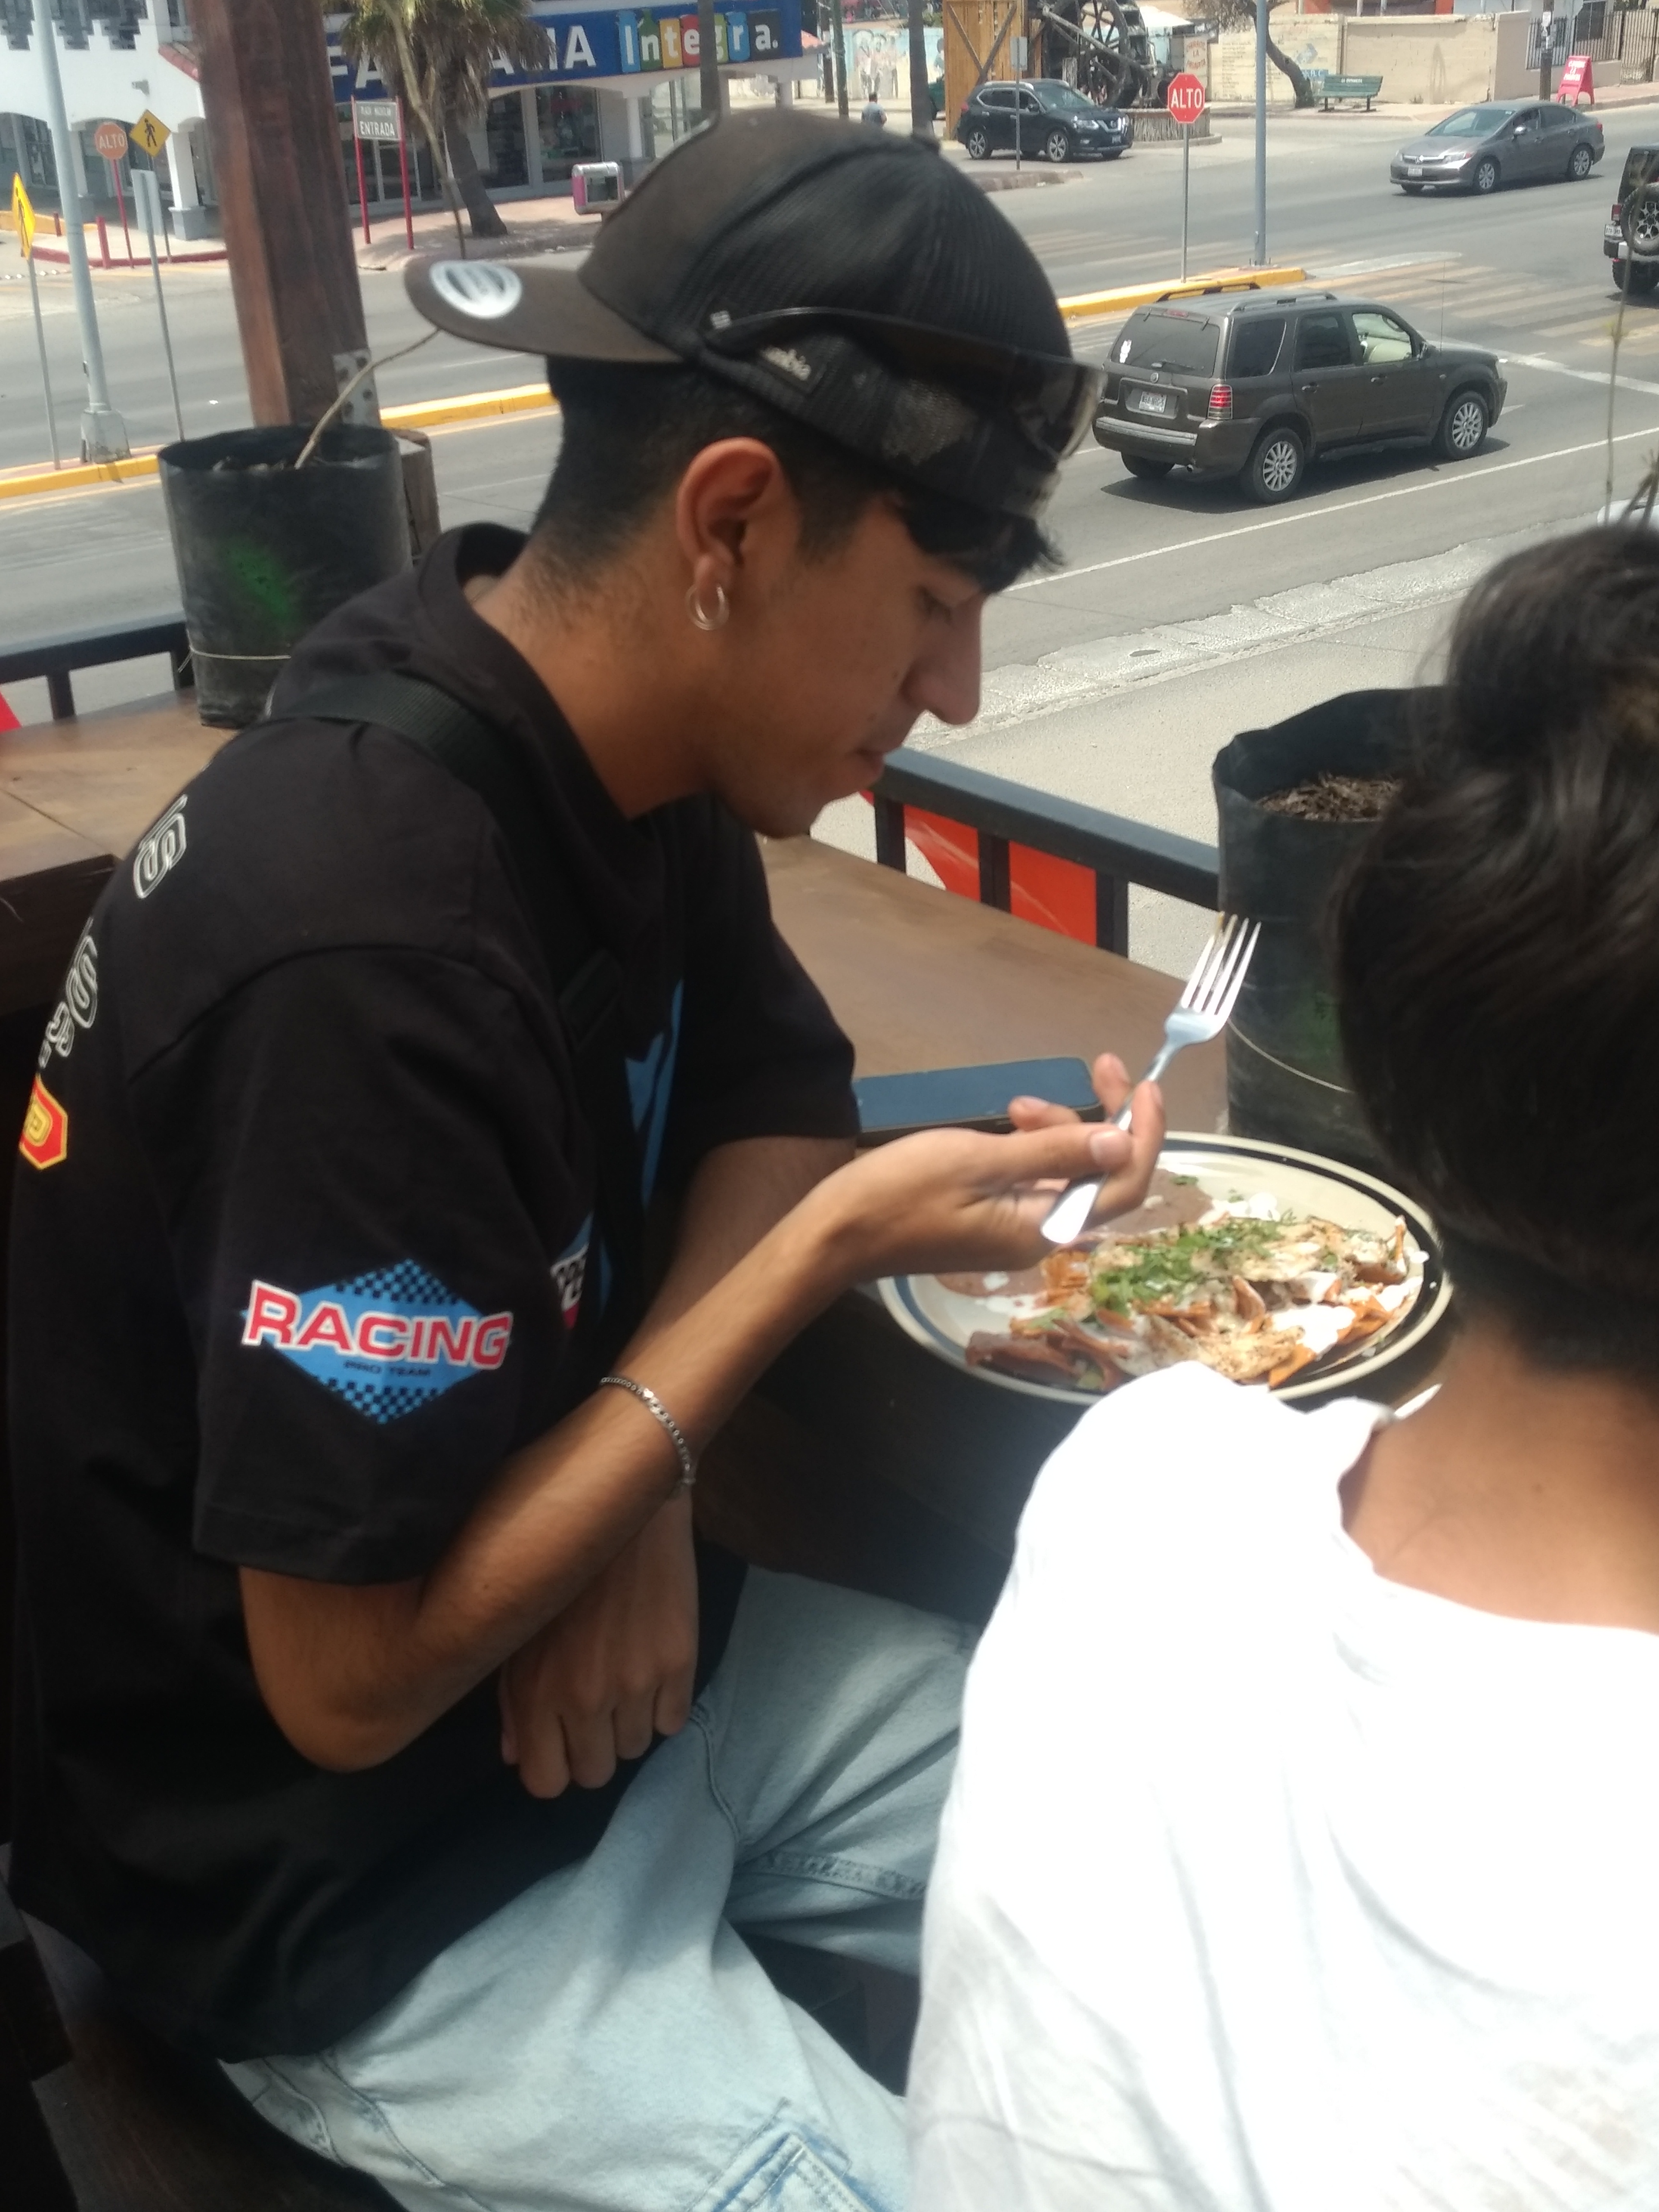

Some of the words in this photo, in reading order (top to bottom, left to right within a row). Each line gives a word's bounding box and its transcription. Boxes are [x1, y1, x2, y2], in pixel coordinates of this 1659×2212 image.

[1171, 88, 1202, 108] ALTO
[360, 120, 395, 136] ENTRADA
[99, 134, 125, 149] ALTO
[241, 1278, 514, 1370] RACING
[344, 1360, 382, 1374] PRO
[389, 1366, 431, 1376] TEAM
